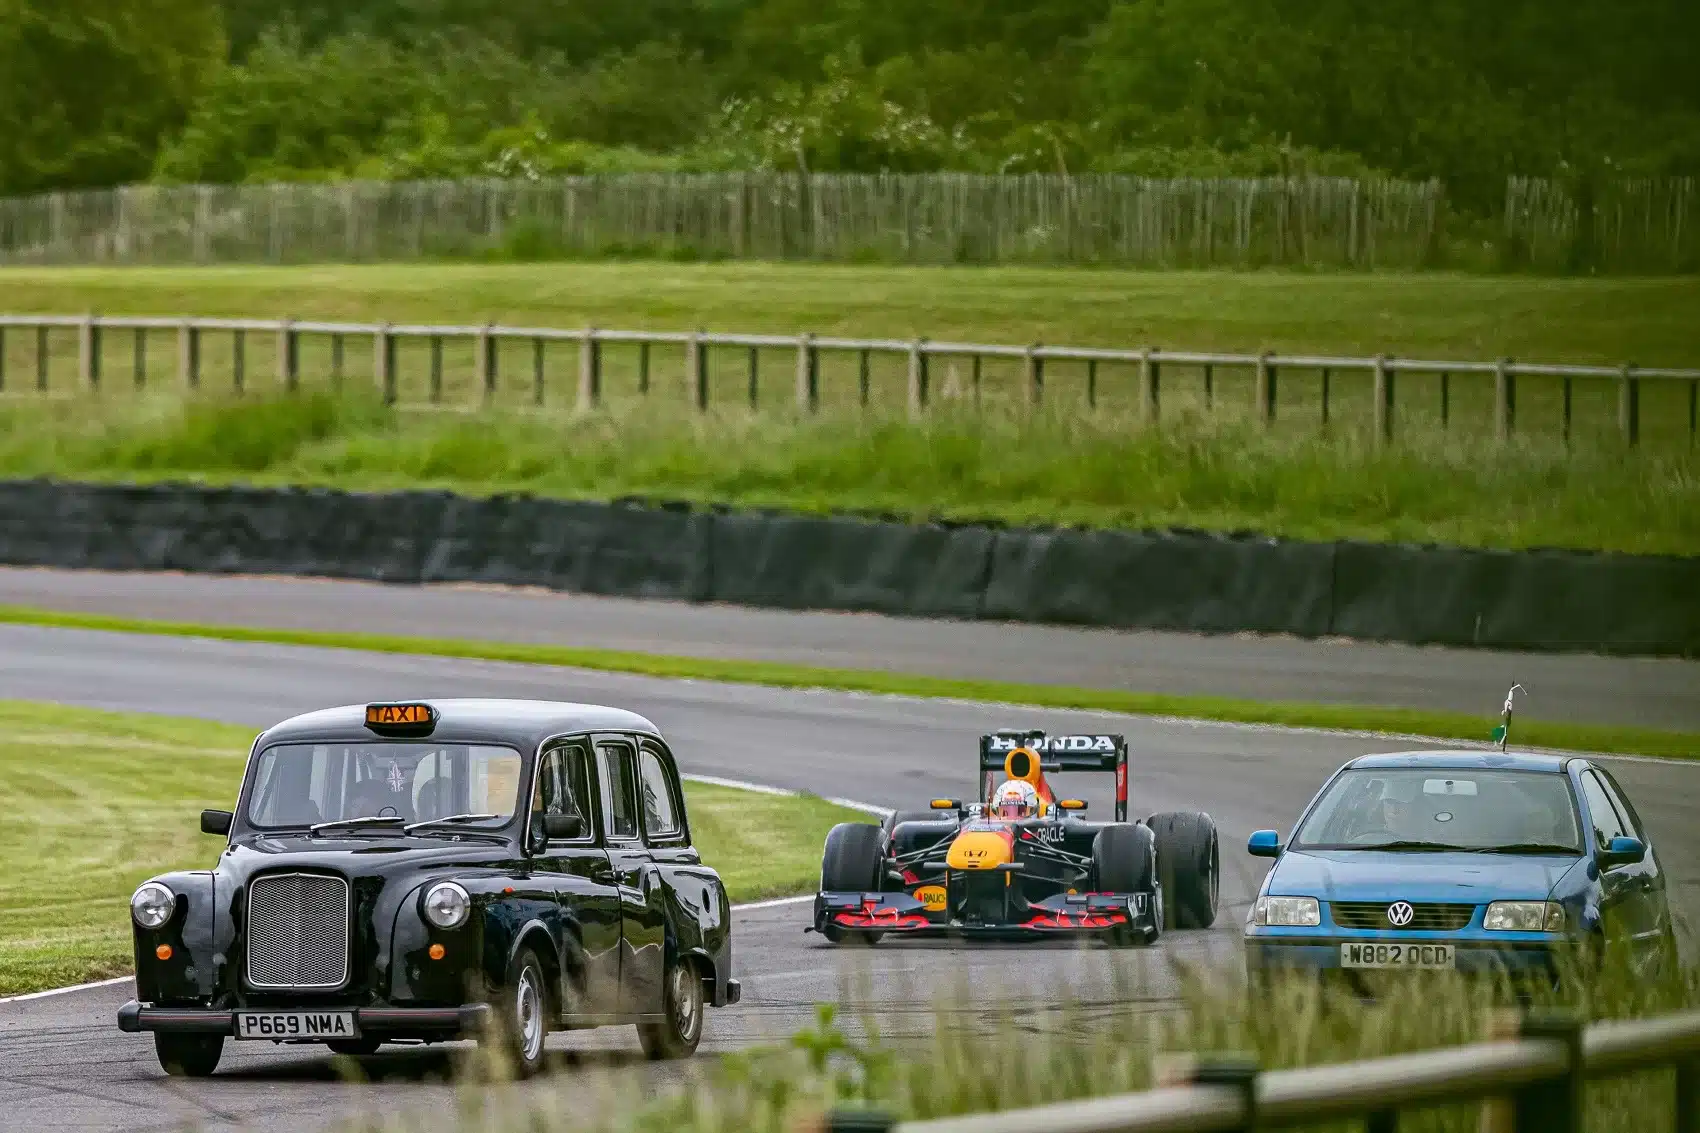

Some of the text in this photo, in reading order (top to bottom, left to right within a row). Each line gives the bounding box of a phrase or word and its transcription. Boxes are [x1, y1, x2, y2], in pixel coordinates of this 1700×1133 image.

[369, 706, 417, 721] TAXI
[991, 736, 1115, 750] HONDA
[1350, 945, 1447, 965] W882 OCD
[245, 1014, 346, 1034] P669 NMA
